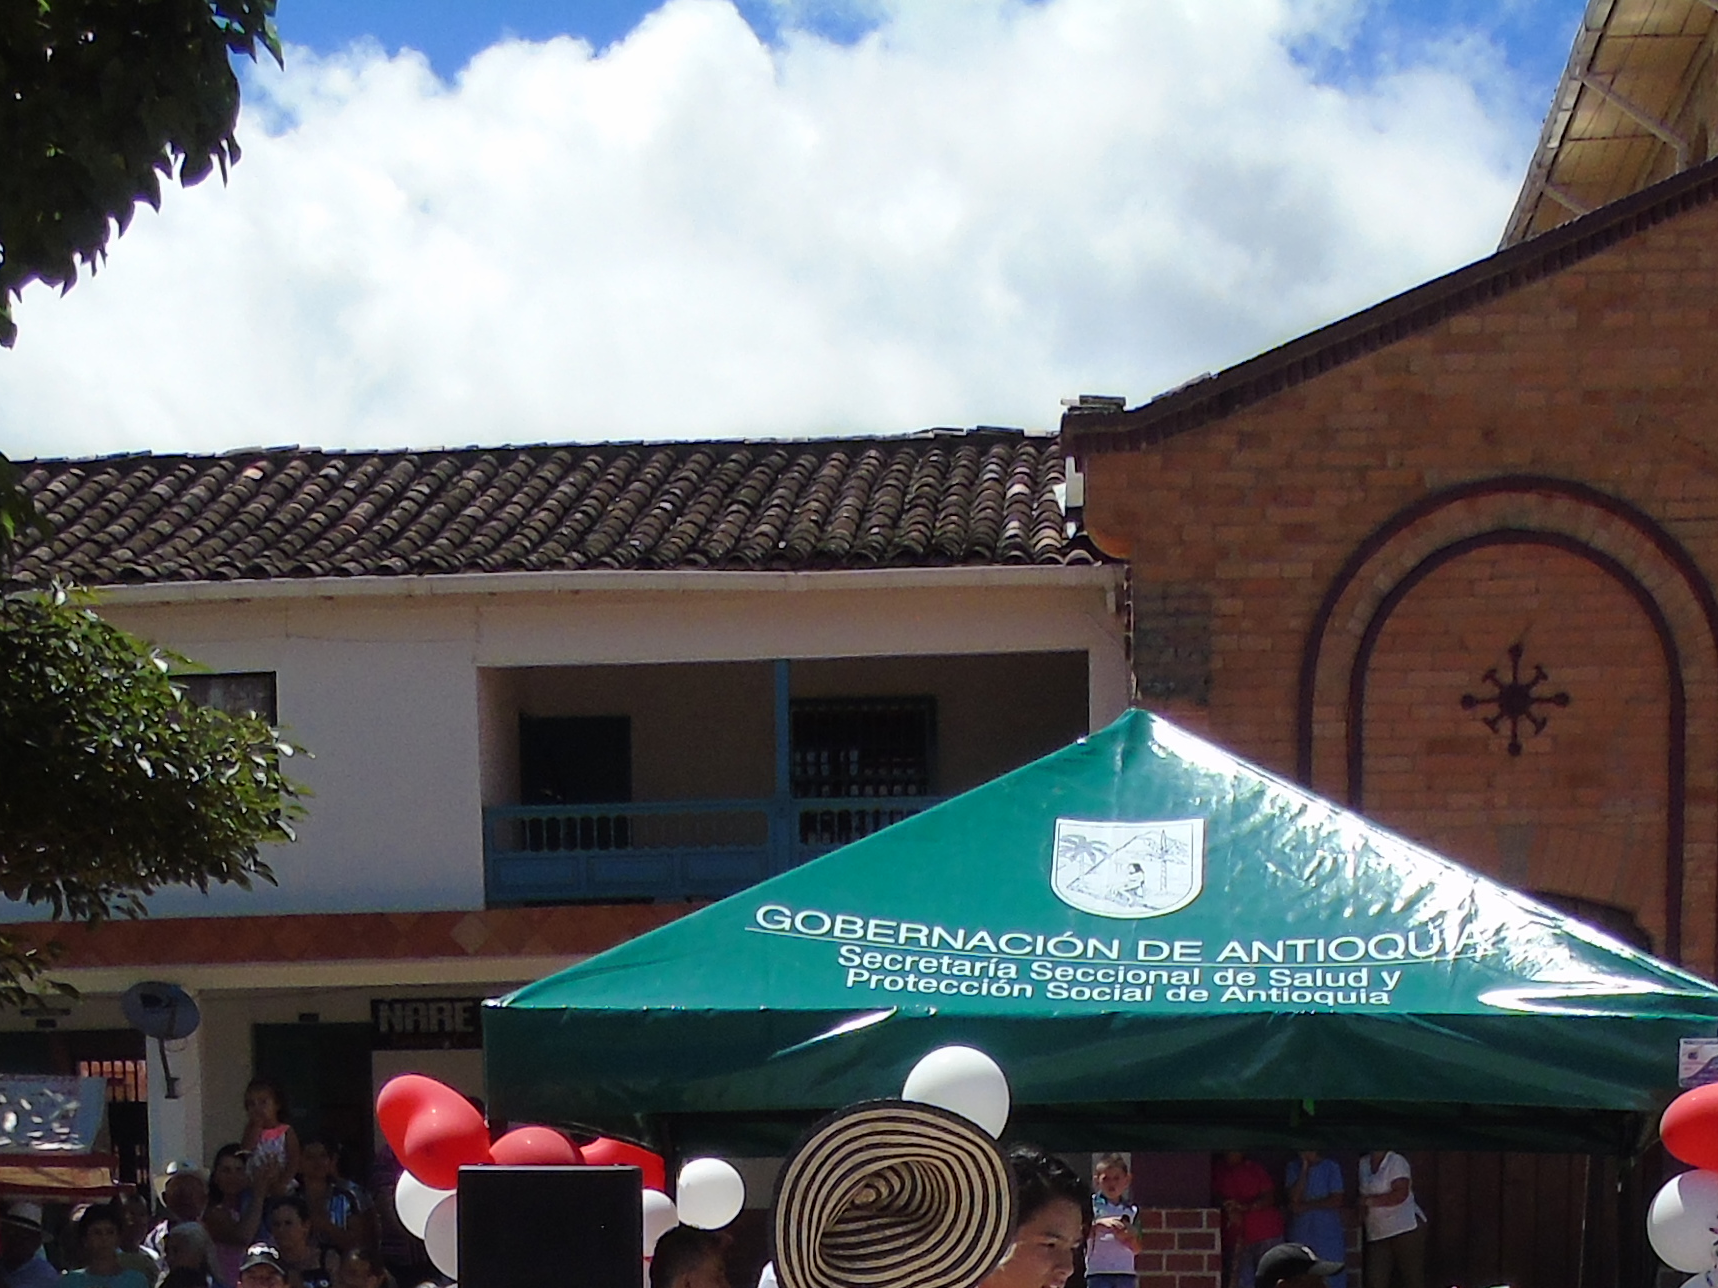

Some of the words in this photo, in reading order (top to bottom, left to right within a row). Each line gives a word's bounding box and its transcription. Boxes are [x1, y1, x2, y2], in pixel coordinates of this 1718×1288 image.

[755, 904, 1120, 960] GOBERNACIÓN
[1137, 939, 1203, 962] DE
[838, 945, 1018, 980] Secretaría
[1030, 961, 1200, 985] Seccional
[1213, 966, 1257, 986] de
[1269, 967, 1369, 988] Salud
[1381, 970, 1401, 991] y
[846, 968, 1032, 999] Protección
[1045, 982, 1151, 1002] Social
[1166, 985, 1208, 1004] de
[1221, 986, 1391, 1007] Antioquia
